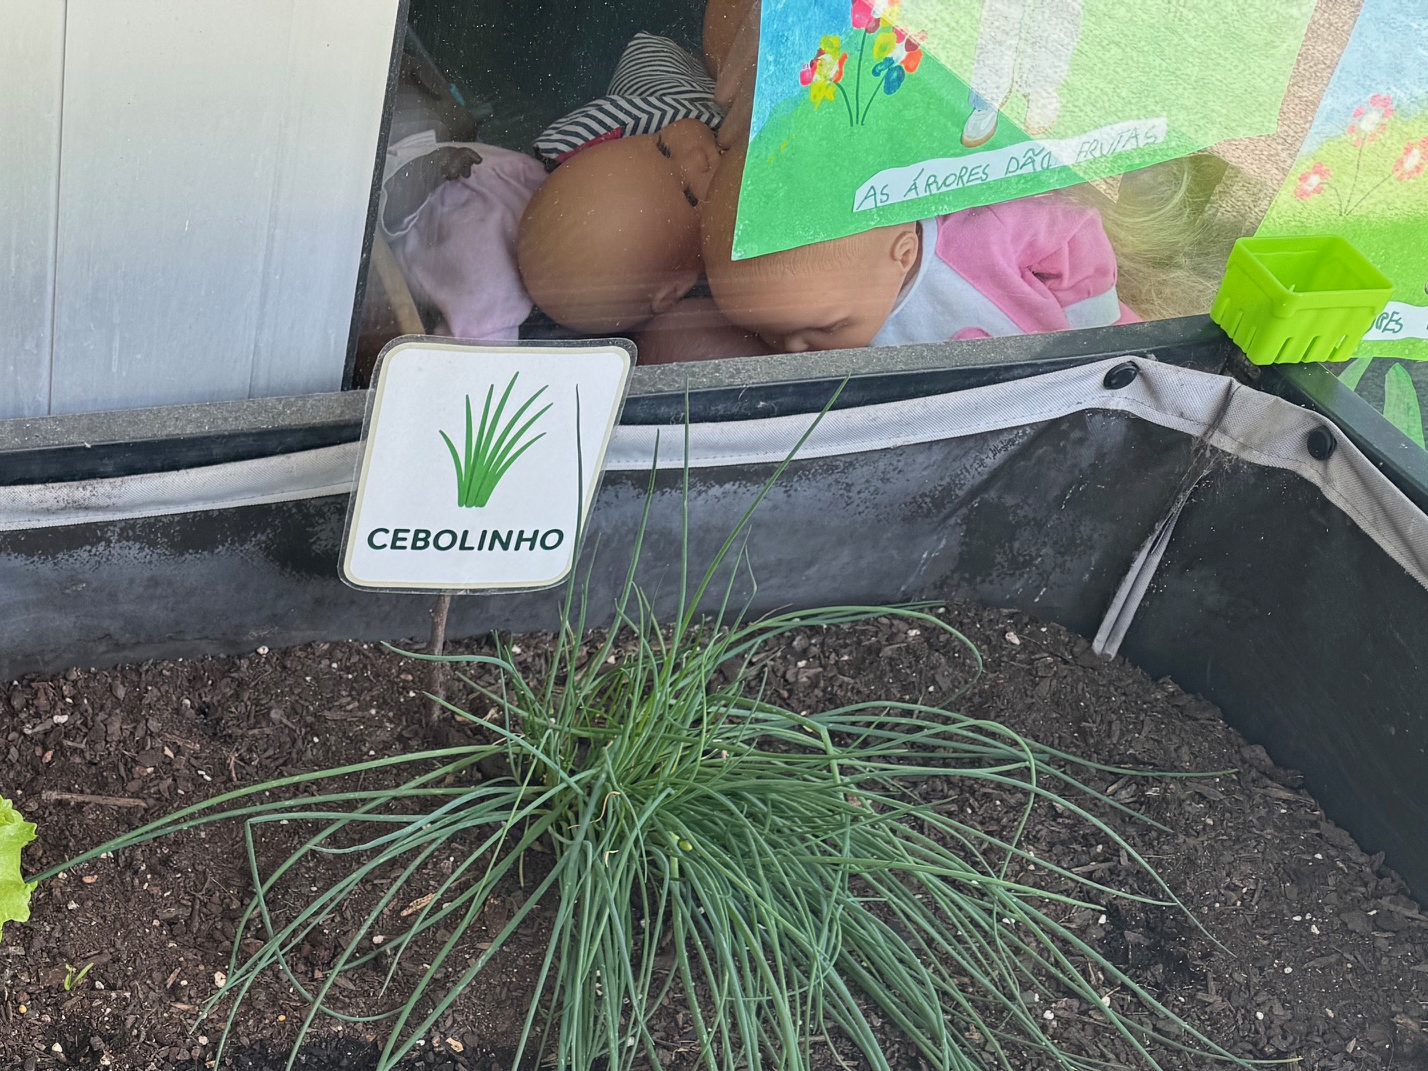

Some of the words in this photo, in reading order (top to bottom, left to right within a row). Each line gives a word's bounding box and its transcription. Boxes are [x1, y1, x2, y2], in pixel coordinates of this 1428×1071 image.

[855, 184, 890, 211] AS
[903, 168, 990, 198] ÁRVORES
[1075, 125, 1158, 163] FRUTAS
[367, 527, 565, 551] CEBOLINHO
